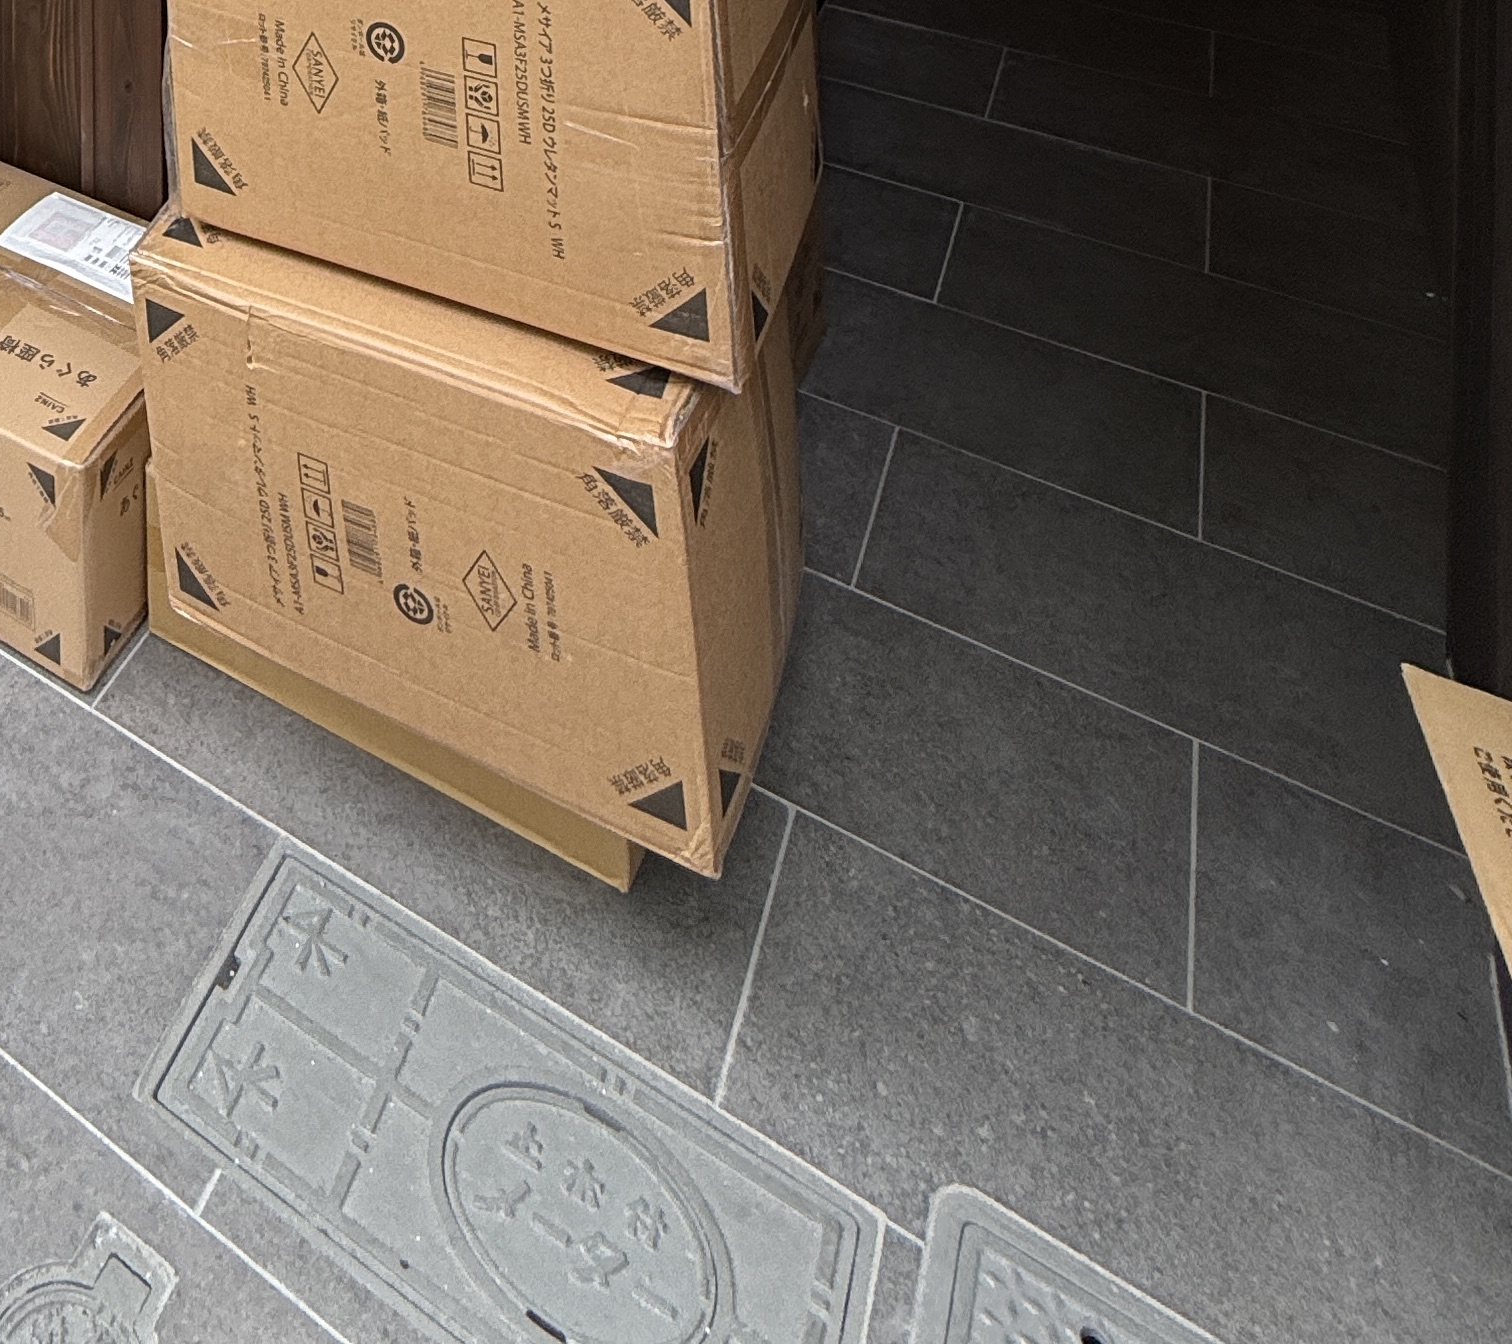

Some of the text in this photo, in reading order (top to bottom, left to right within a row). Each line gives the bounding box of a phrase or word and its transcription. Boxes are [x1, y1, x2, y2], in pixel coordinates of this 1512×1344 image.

[274, 19, 286, 55] Made
[278, 71, 290, 107] China
[311, 50, 326, 99] SANYEI
[537, 1, 566, 260] メサイア 3つ折り 25D ウレタンマット S WH
[196, 126, 249, 191] 角落厳禁
[630, 266, 696, 319] 角落厳禁
[155, 323, 201, 363] 角落厳禁
[34, 394, 65, 414] CAINZ
[245, 384, 257, 407] WH
[248, 414, 260, 424] S
[251, 424, 267, 498] ウレタンマット
[258, 499, 272, 523] 25D
[576, 471, 651, 549] 角落厳禁
[179, 540, 232, 611] 角落厳禁
[477, 564, 495, 616] SANYEI
[520, 563, 535, 600] China
[526, 614, 541, 654] Made
[607, 755, 672, 795] 角落厳禁
